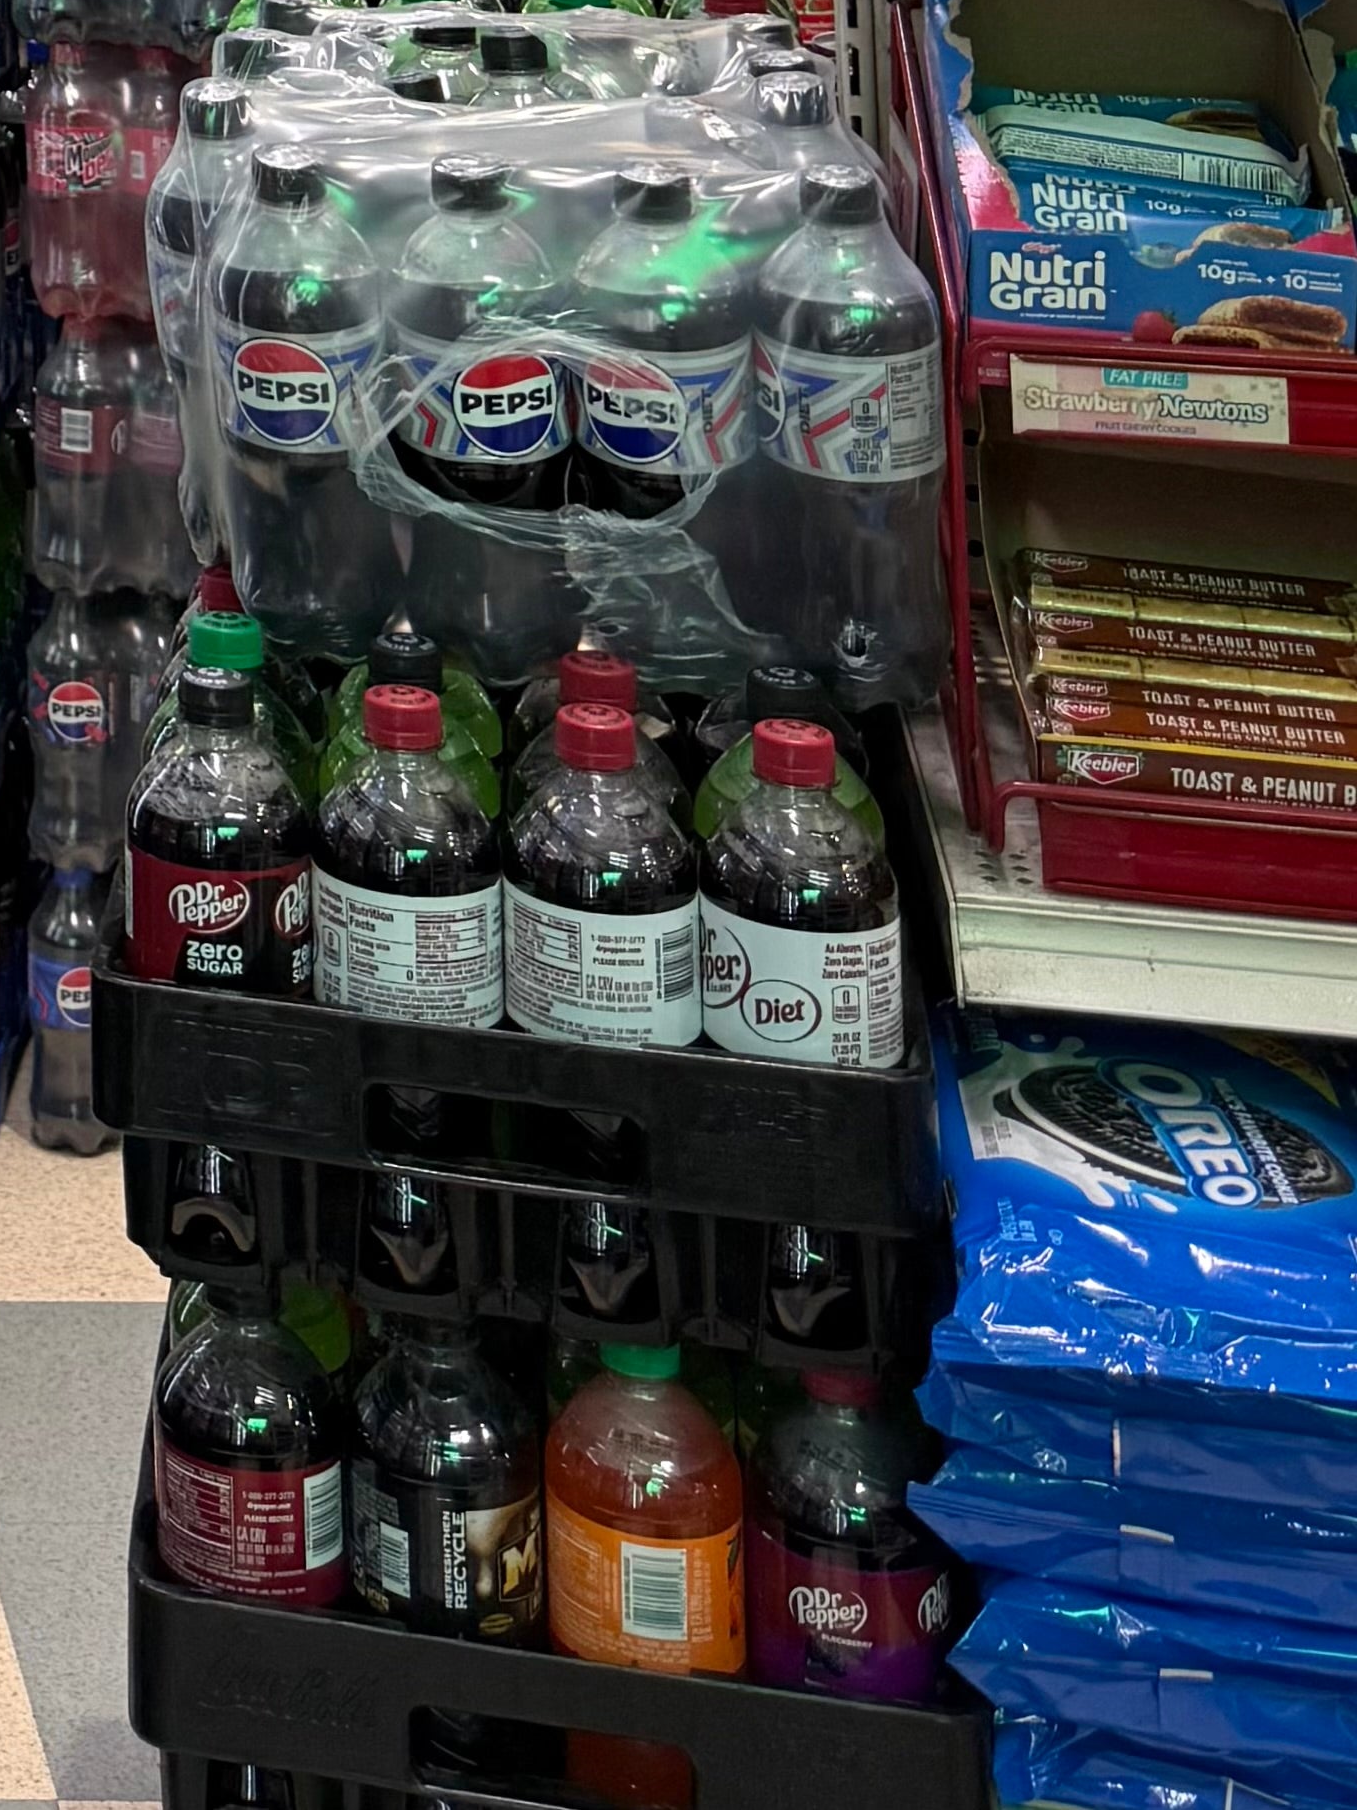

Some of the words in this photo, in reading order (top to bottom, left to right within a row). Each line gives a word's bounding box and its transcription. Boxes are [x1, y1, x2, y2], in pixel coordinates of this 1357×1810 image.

[1031, 183, 1125, 208] Nutri
[1146, 200, 1181, 215] 10g
[1035, 206, 1127, 230] Grain
[990, 251, 1107, 286] Nutri
[1198, 264, 1236, 284] 10g
[1283, 274, 1307, 290] 10
[990, 284, 1107, 311] Grain
[237, 373, 331, 405] PEPSI
[1109, 371, 1143, 385] FAT
[1144, 372, 1183, 387] FREE
[458, 386, 553, 416] PEPSI
[586, 385, 678, 425] PEPSI
[1159, 395, 1269, 422] Newtons
[1189, 573, 1244, 591] PEANUT
[1250, 580, 1305, 596] BUTTER
[1037, 613, 1093, 629] Keebler
[1127, 626, 1174, 642] TOAST
[1198, 634, 1254, 651] PEANUT
[1259, 641, 1316, 657] BUTTER
[1051, 679, 1107, 695] Keebler
[1142, 690, 1191, 706] TOAST
[1215, 698, 1271, 716] PEANUT
[1277, 705, 1336, 722] BUTTER
[1053, 699, 1110, 716] Keebler
[1147, 713, 1195, 729] TOAST
[1221, 721, 1280, 738] PEANUT
[1286, 729, 1345, 745] BUTTER
[1068, 751, 1139, 776] Keebler
[1171, 768, 1234, 793] TOAST
[1242, 776, 1257, 793] &
[1263, 777, 1337, 802] PEANUT
[186, 940, 244, 962] zero
[186, 958, 244, 976] SUGAR
[755, 998, 805, 1025] Diet
[1113, 1061, 1259, 1206] OREO
[454, 1510, 468, 1610] RECYCLE
